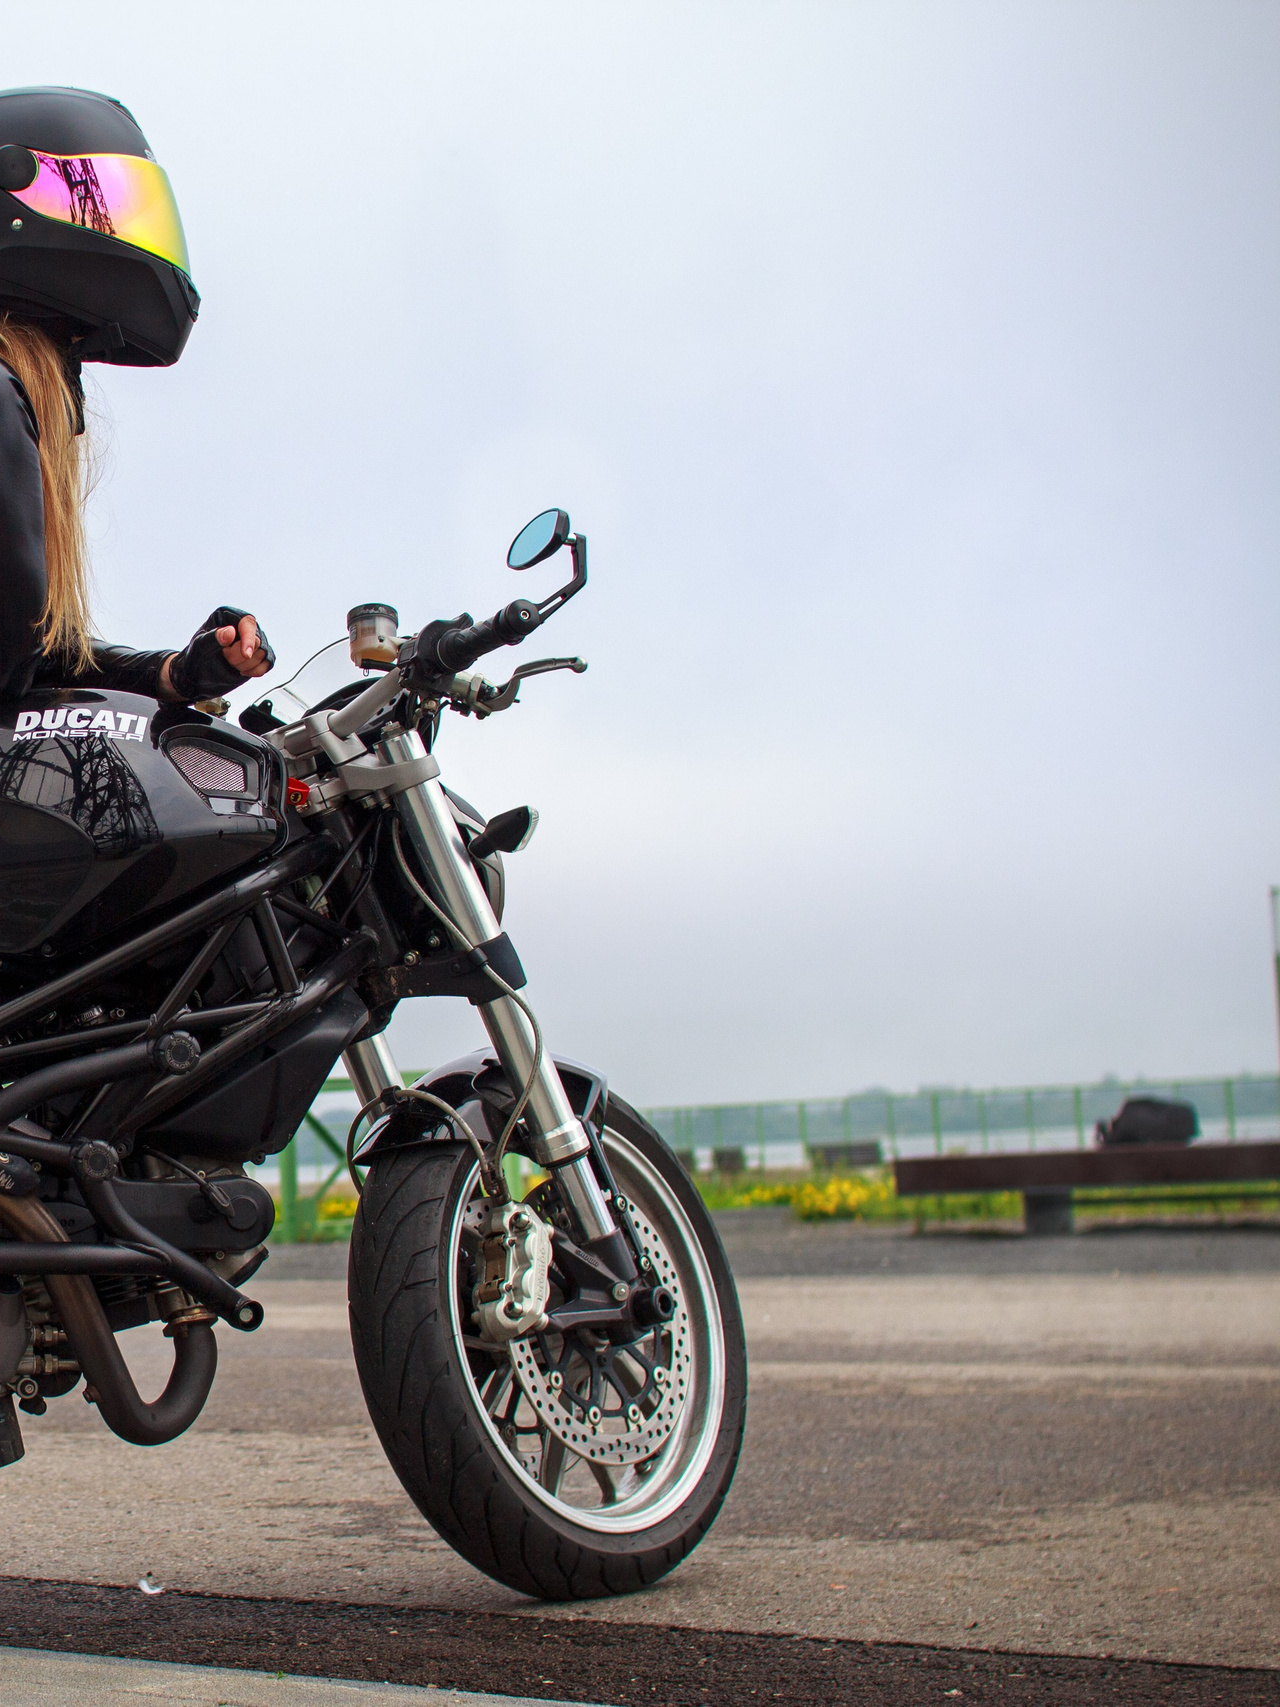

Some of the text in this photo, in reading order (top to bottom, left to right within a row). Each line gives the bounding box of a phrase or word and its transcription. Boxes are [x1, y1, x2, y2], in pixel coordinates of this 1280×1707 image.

[13, 729, 145, 742] MONSTER
[15, 708, 148, 737] DUCATI
[537, 1247, 545, 1298] brembo
